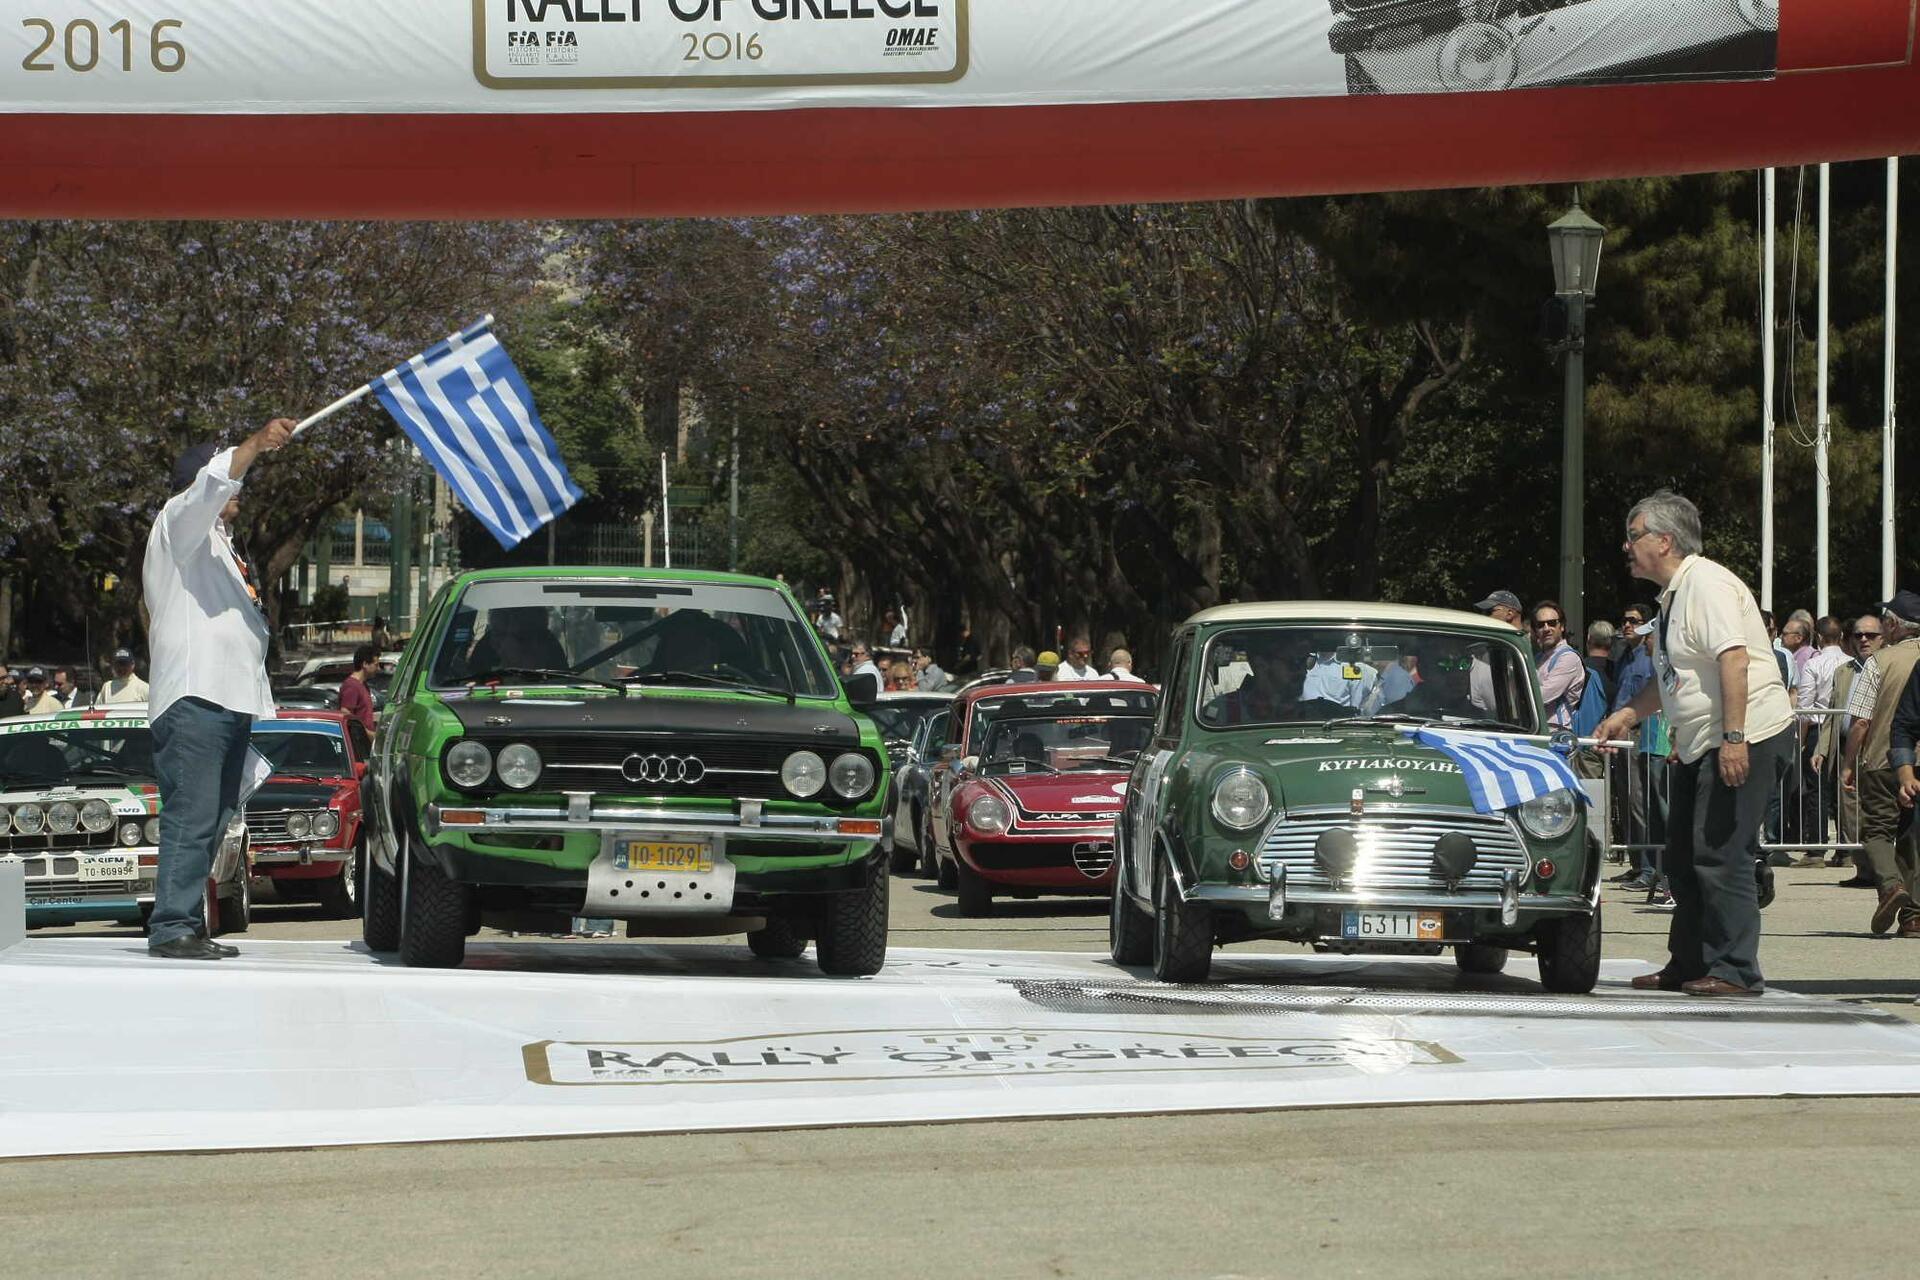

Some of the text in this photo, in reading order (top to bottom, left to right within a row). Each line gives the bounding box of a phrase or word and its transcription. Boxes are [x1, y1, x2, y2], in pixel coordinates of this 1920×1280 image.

[21, 18, 187, 72] 2016
[886, 28, 938, 46] OMAE
[682, 32, 763, 61] 2016
[8, 720, 145, 733] LANCIA TOTIP
[48, 896, 83, 905] Center
[1347, 926, 1358, 934] GR
[1362, 915, 1411, 934] 6311
[587, 1049, 856, 1068] RALLY
[889, 1050, 1016, 1062] OF
[920, 1061, 1076, 1072] 2016
